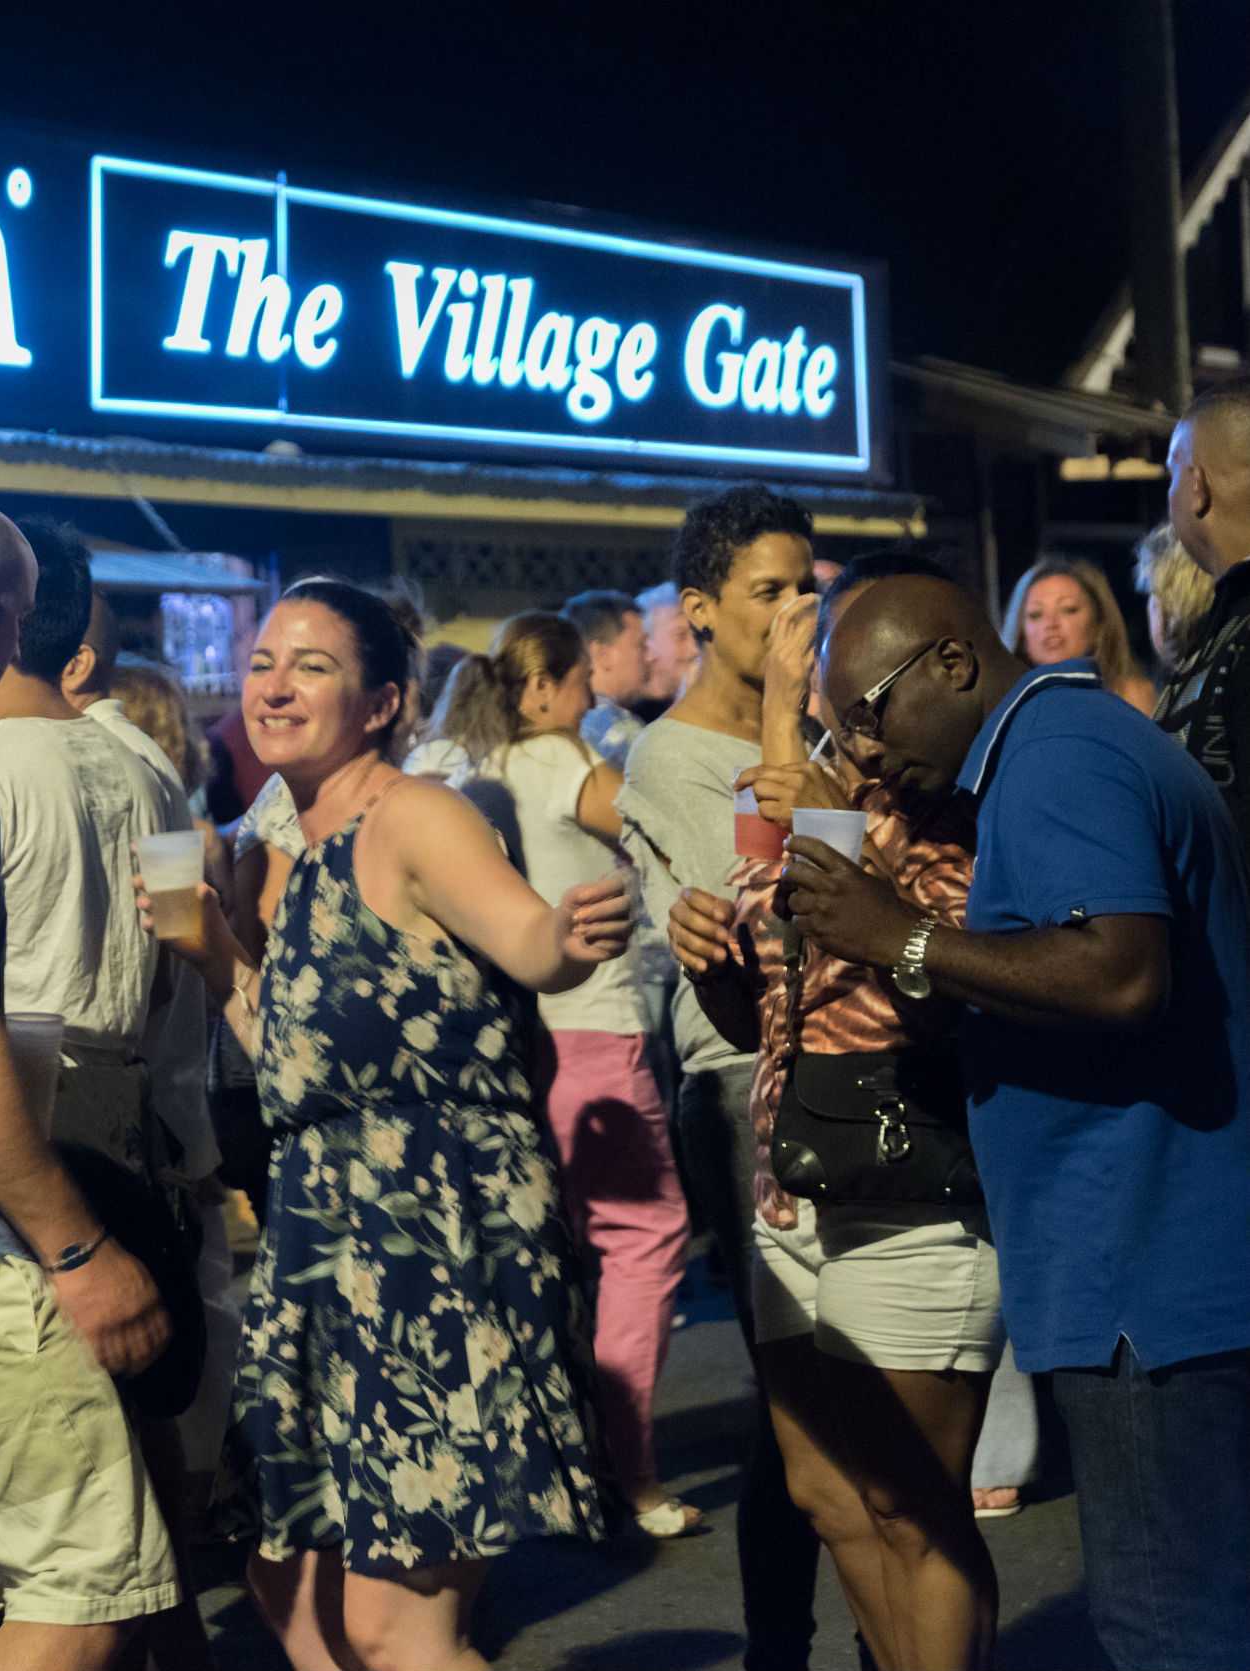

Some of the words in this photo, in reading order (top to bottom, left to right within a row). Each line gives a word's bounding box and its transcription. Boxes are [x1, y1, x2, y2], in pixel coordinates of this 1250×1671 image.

[162, 229, 343, 368] The
[384, 261, 657, 423] Village
[684, 304, 837, 417] Gate
